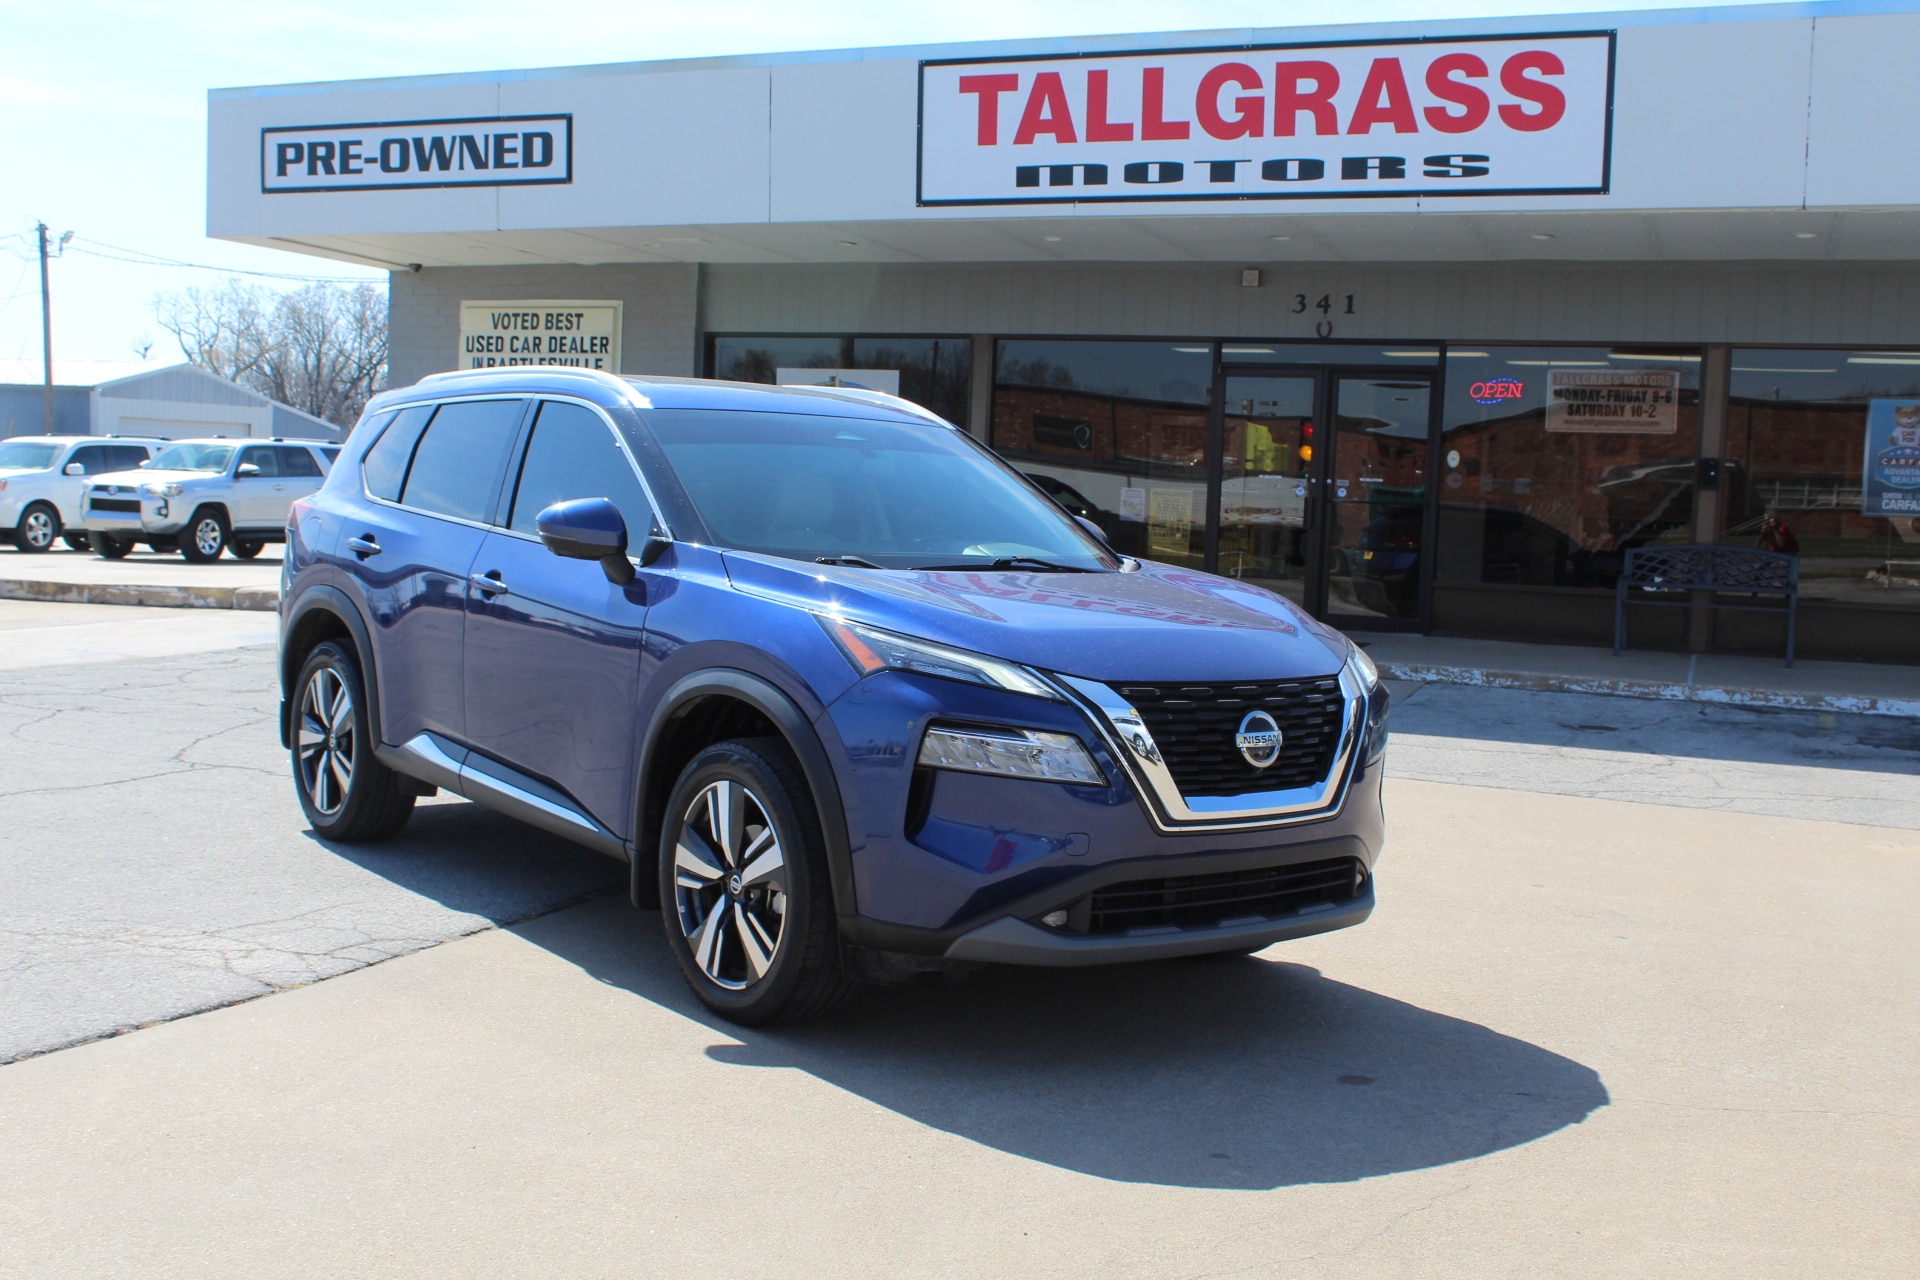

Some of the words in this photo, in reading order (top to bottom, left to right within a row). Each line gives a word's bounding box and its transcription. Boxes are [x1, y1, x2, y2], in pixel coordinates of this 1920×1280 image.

[959, 50, 1566, 146] TALLGRASS
[276, 131, 554, 177] PRE-OWNED
[1292, 293, 1356, 315] 341
[491, 312, 540, 330] VOTED
[544, 312, 584, 330] BEST
[466, 335, 504, 353] USED
[510, 335, 542, 353] CAR
[549, 336, 610, 354] DEALER
[472, 357, 484, 369] IN
[1556, 374, 1619, 385] TALLGRASS
[1624, 375, 1673, 386] MOTORS
[1469, 382, 1524, 398] OPEN
[1553, 388, 1648, 403] MONDAY-FRIDAY
[1652, 390, 1673, 404] 9-6
[1567, 403, 1627, 417] SATURDAY
[1630, 404, 1657, 418] 10-2
[1243, 734, 1279, 744] NISSAN
